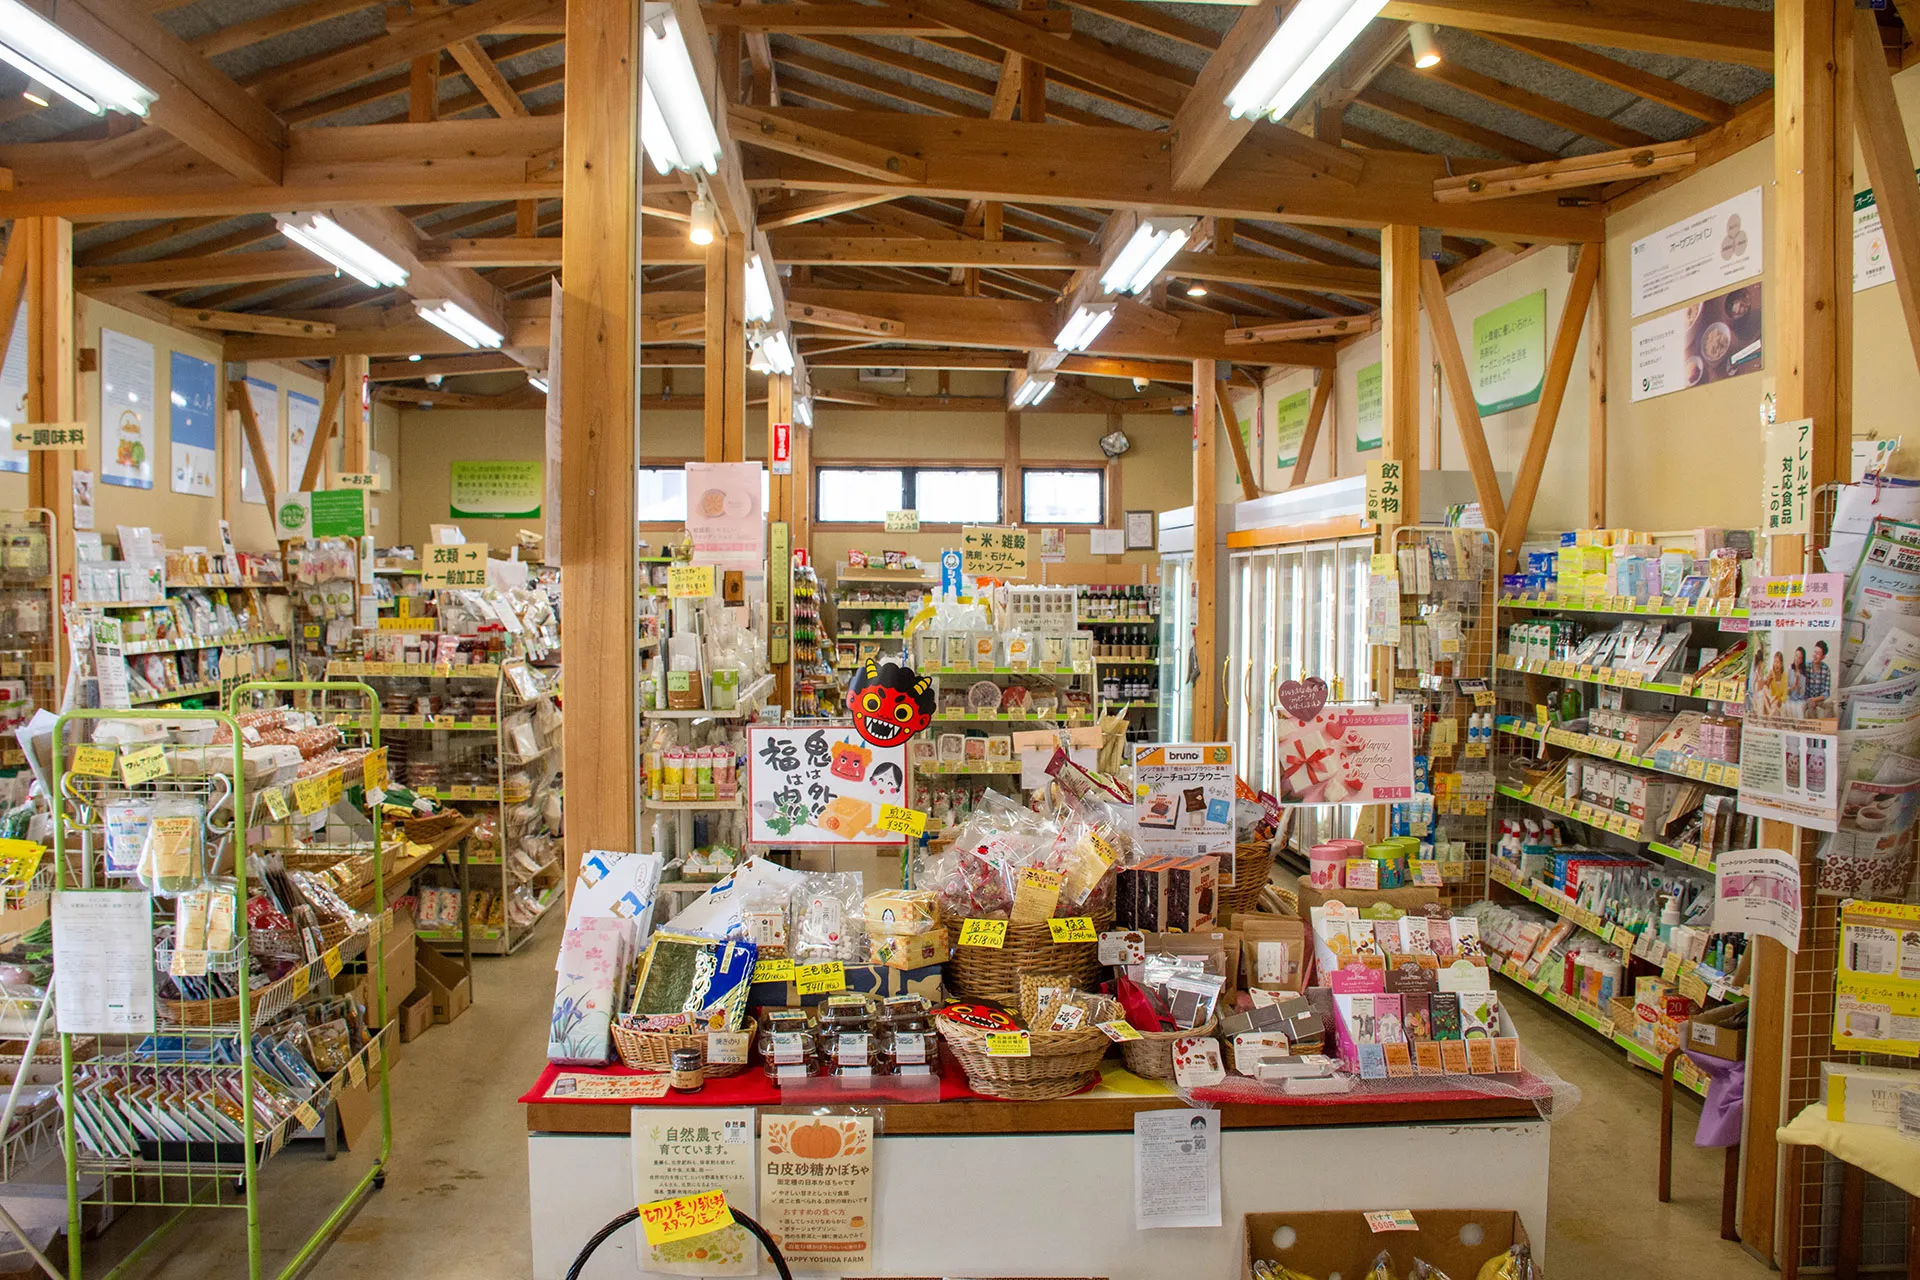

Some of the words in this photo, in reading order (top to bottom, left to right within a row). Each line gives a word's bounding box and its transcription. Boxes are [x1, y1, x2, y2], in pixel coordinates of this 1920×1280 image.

[33, 428, 85, 446] 調味料
[352, 475, 373, 485] お茶
[1797, 425, 1809, 521] アレルギー
[1381, 463, 1399, 513] 飲み物
[1781, 456, 1793, 524] 対応食品
[1368, 489, 1378, 520] この裏
[1769, 485, 1779, 528] この裏
[981, 533, 1026, 549] 米・雑穀
[433, 548, 458, 563] 衣類
[966, 550, 1015, 561] 洗剤・石けん
[969, 562, 1012, 572] シャンプー
[436, 569, 485, 585] 一般加工品
[1360, 738, 1393, 752] Happy
[1169, 752, 1199, 760] bruno
[1140, 773, 1230, 781] イージーチョコブラウニー
[1350, 767, 1371, 781] Day
[1378, 787, 1403, 798] 2.14
[801, 962, 842, 977] 三色福豆
[1669, 1001, 1683, 1013] 20
[666, 1126, 722, 1143] 自然農で
[659, 1144, 728, 1156] 育てています。
[767, 1162, 870, 1177] 白皮砂糖かぼちゃ
[777, 1178, 856, 1186] 固定種の日本かぼちゃです
[784, 1208, 846, 1216] おすすめの食べ方
[1369, 1213, 1391, 1221] バナナ
[1372, 1220, 1396, 1231] 500円
[784, 1256, 809, 1264] HAPPY
[810, 1256, 842, 1264] YOSHIDA
